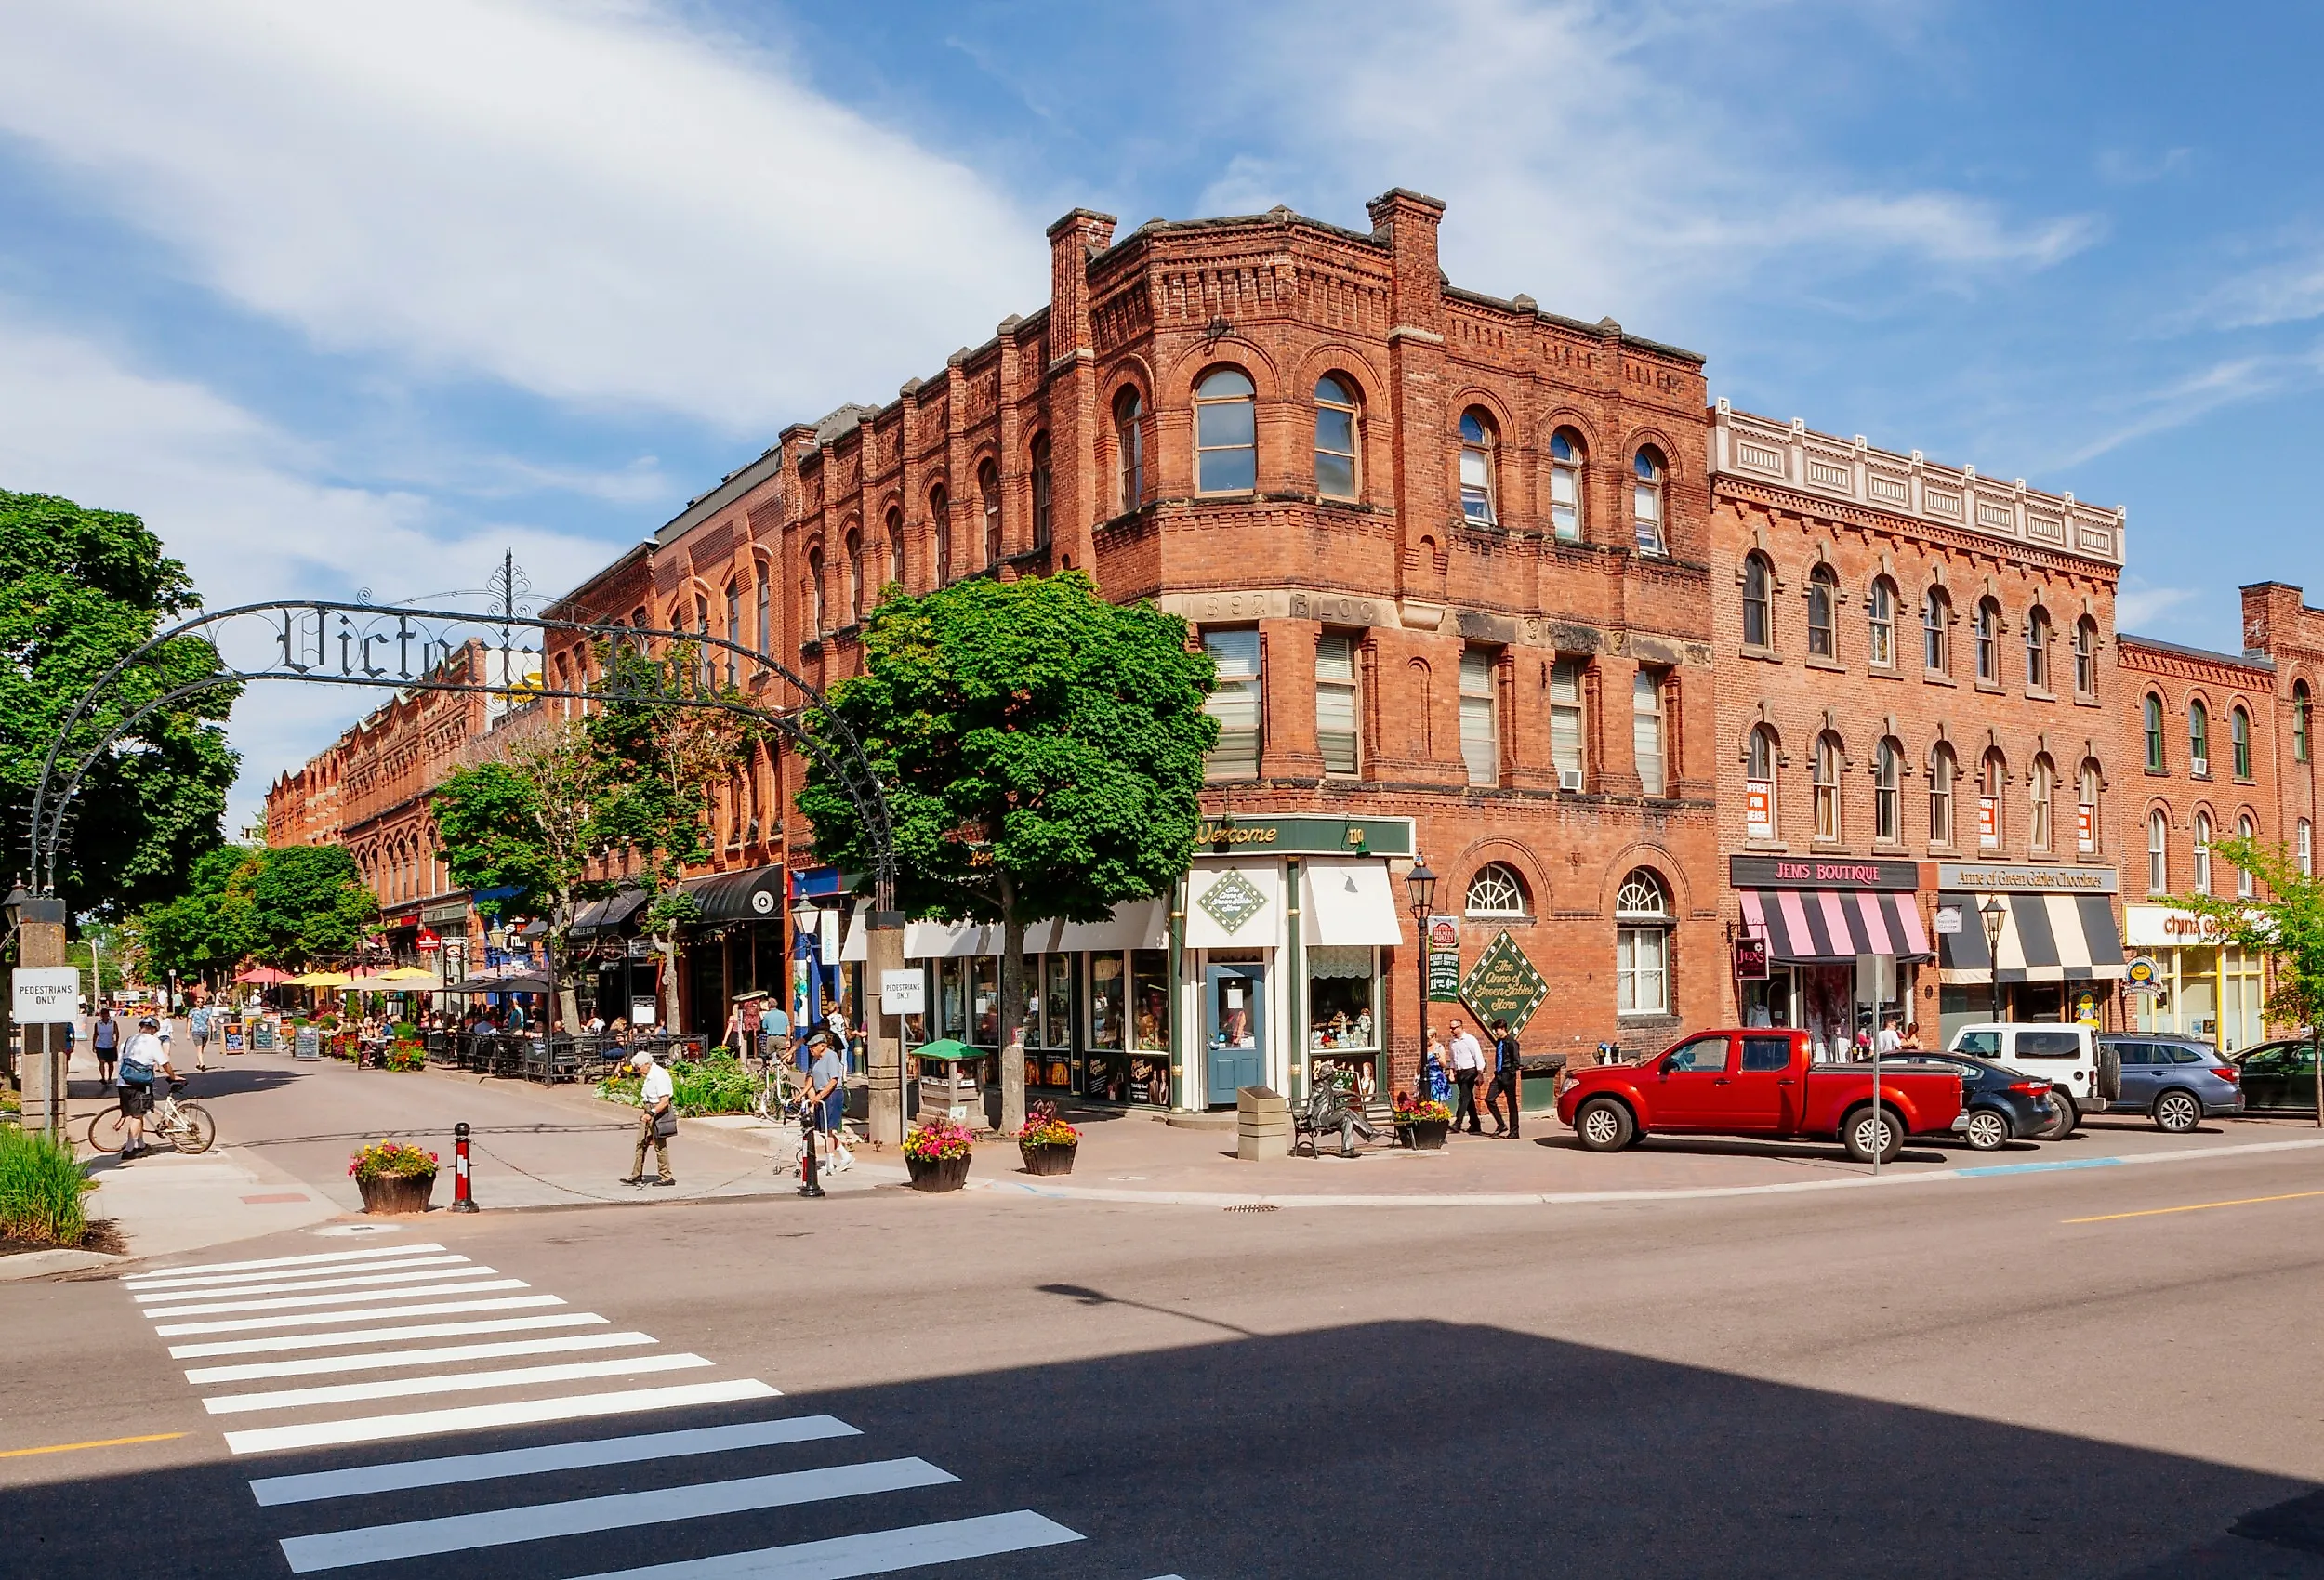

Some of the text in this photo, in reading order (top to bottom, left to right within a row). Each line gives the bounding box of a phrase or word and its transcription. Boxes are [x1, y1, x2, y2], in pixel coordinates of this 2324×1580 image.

[1189, 594, 1266, 620] 1892
[276, 607, 550, 692] Victoria
[1750, 796, 1763, 808] FOR
[1748, 810, 1767, 822] LEASE
[1979, 823, 1992, 833] EASE
[1775, 862, 1881, 885] JEMS BOUTIQUE
[1958, 870, 2102, 888] Anne of Green Gables Chocolates
[1494, 959, 1514, 973] The
[1486, 971, 1523, 987] Anne of
[20, 985, 73, 994] PEDESTRIANS
[886, 983, 921, 992] PEDESTRIANS
[1474, 983, 1534, 998] Green Gables
[35, 995, 56, 1005] ONLY
[896, 992, 910, 1000] ONLY
[1491, 997, 1518, 1012] Store
